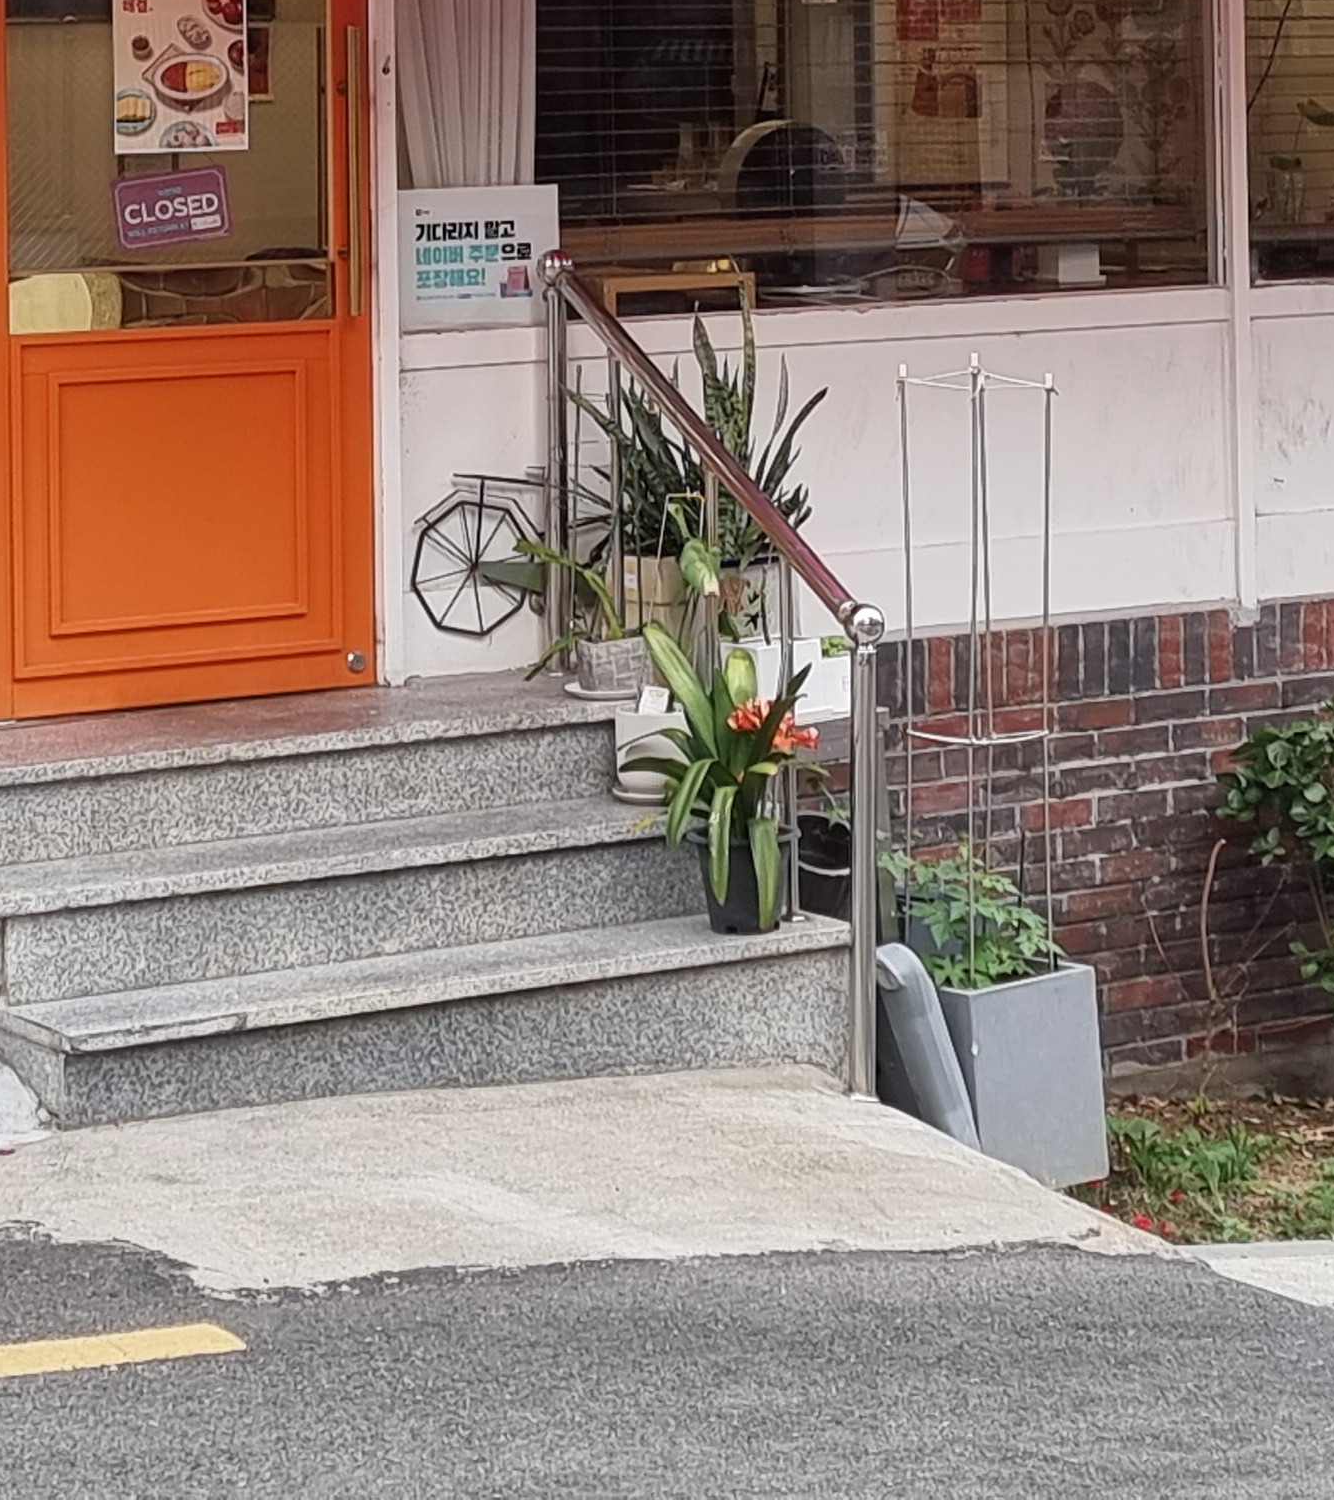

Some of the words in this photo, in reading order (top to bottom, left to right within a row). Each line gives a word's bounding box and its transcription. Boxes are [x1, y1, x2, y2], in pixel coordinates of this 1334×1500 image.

[124, 192, 219, 225] CLOSED
[415, 221, 479, 242] 기다리지
[484, 220, 516, 240] 말고
[415, 246, 464, 265] 네이버
[416, 268, 486, 289] 포장해요!
